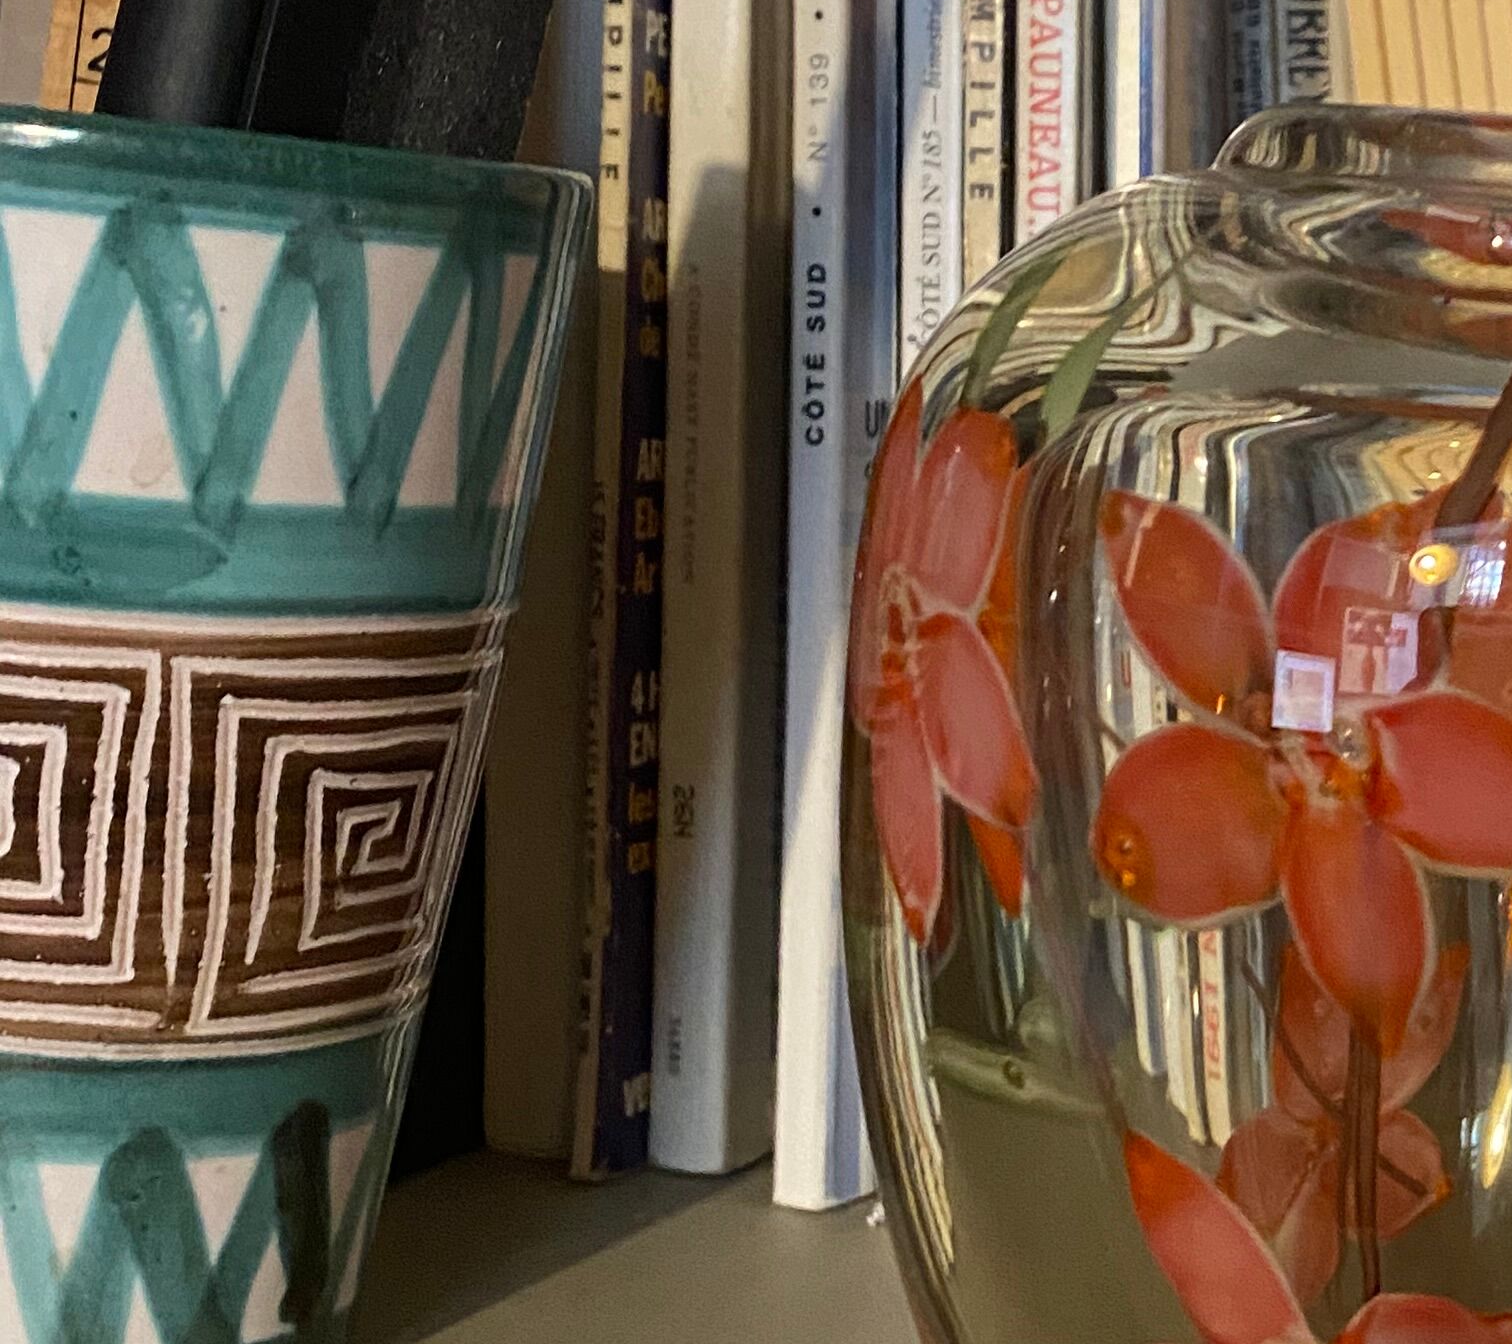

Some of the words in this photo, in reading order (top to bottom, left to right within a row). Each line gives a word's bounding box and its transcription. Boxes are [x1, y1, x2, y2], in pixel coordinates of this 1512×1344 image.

[809, 54, 831, 113] 139
[922, 212, 942, 265] SUD
[807, 261, 827, 335] SUD
[802, 353, 826, 447] CÔTÉ
